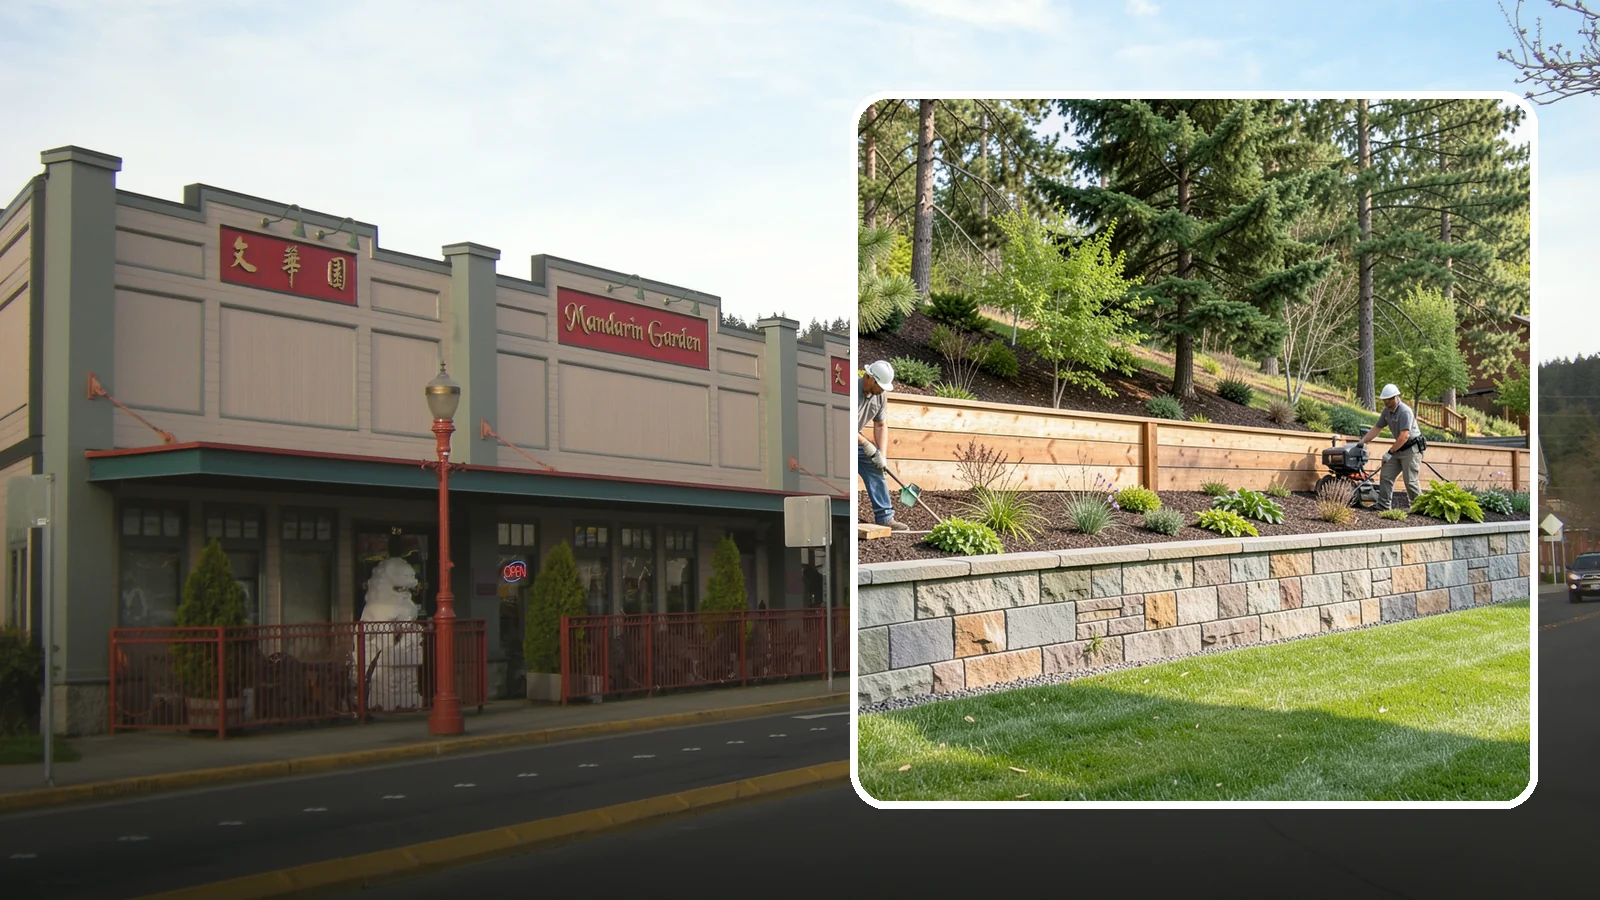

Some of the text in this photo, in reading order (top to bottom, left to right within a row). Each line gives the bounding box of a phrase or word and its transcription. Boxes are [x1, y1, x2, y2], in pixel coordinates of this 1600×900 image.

[231, 236, 346, 290] 文華園
[564, 302, 701, 352] Mandarin Garden
[835, 363, 846, 386] 文
[503, 565, 527, 578] OPEN
